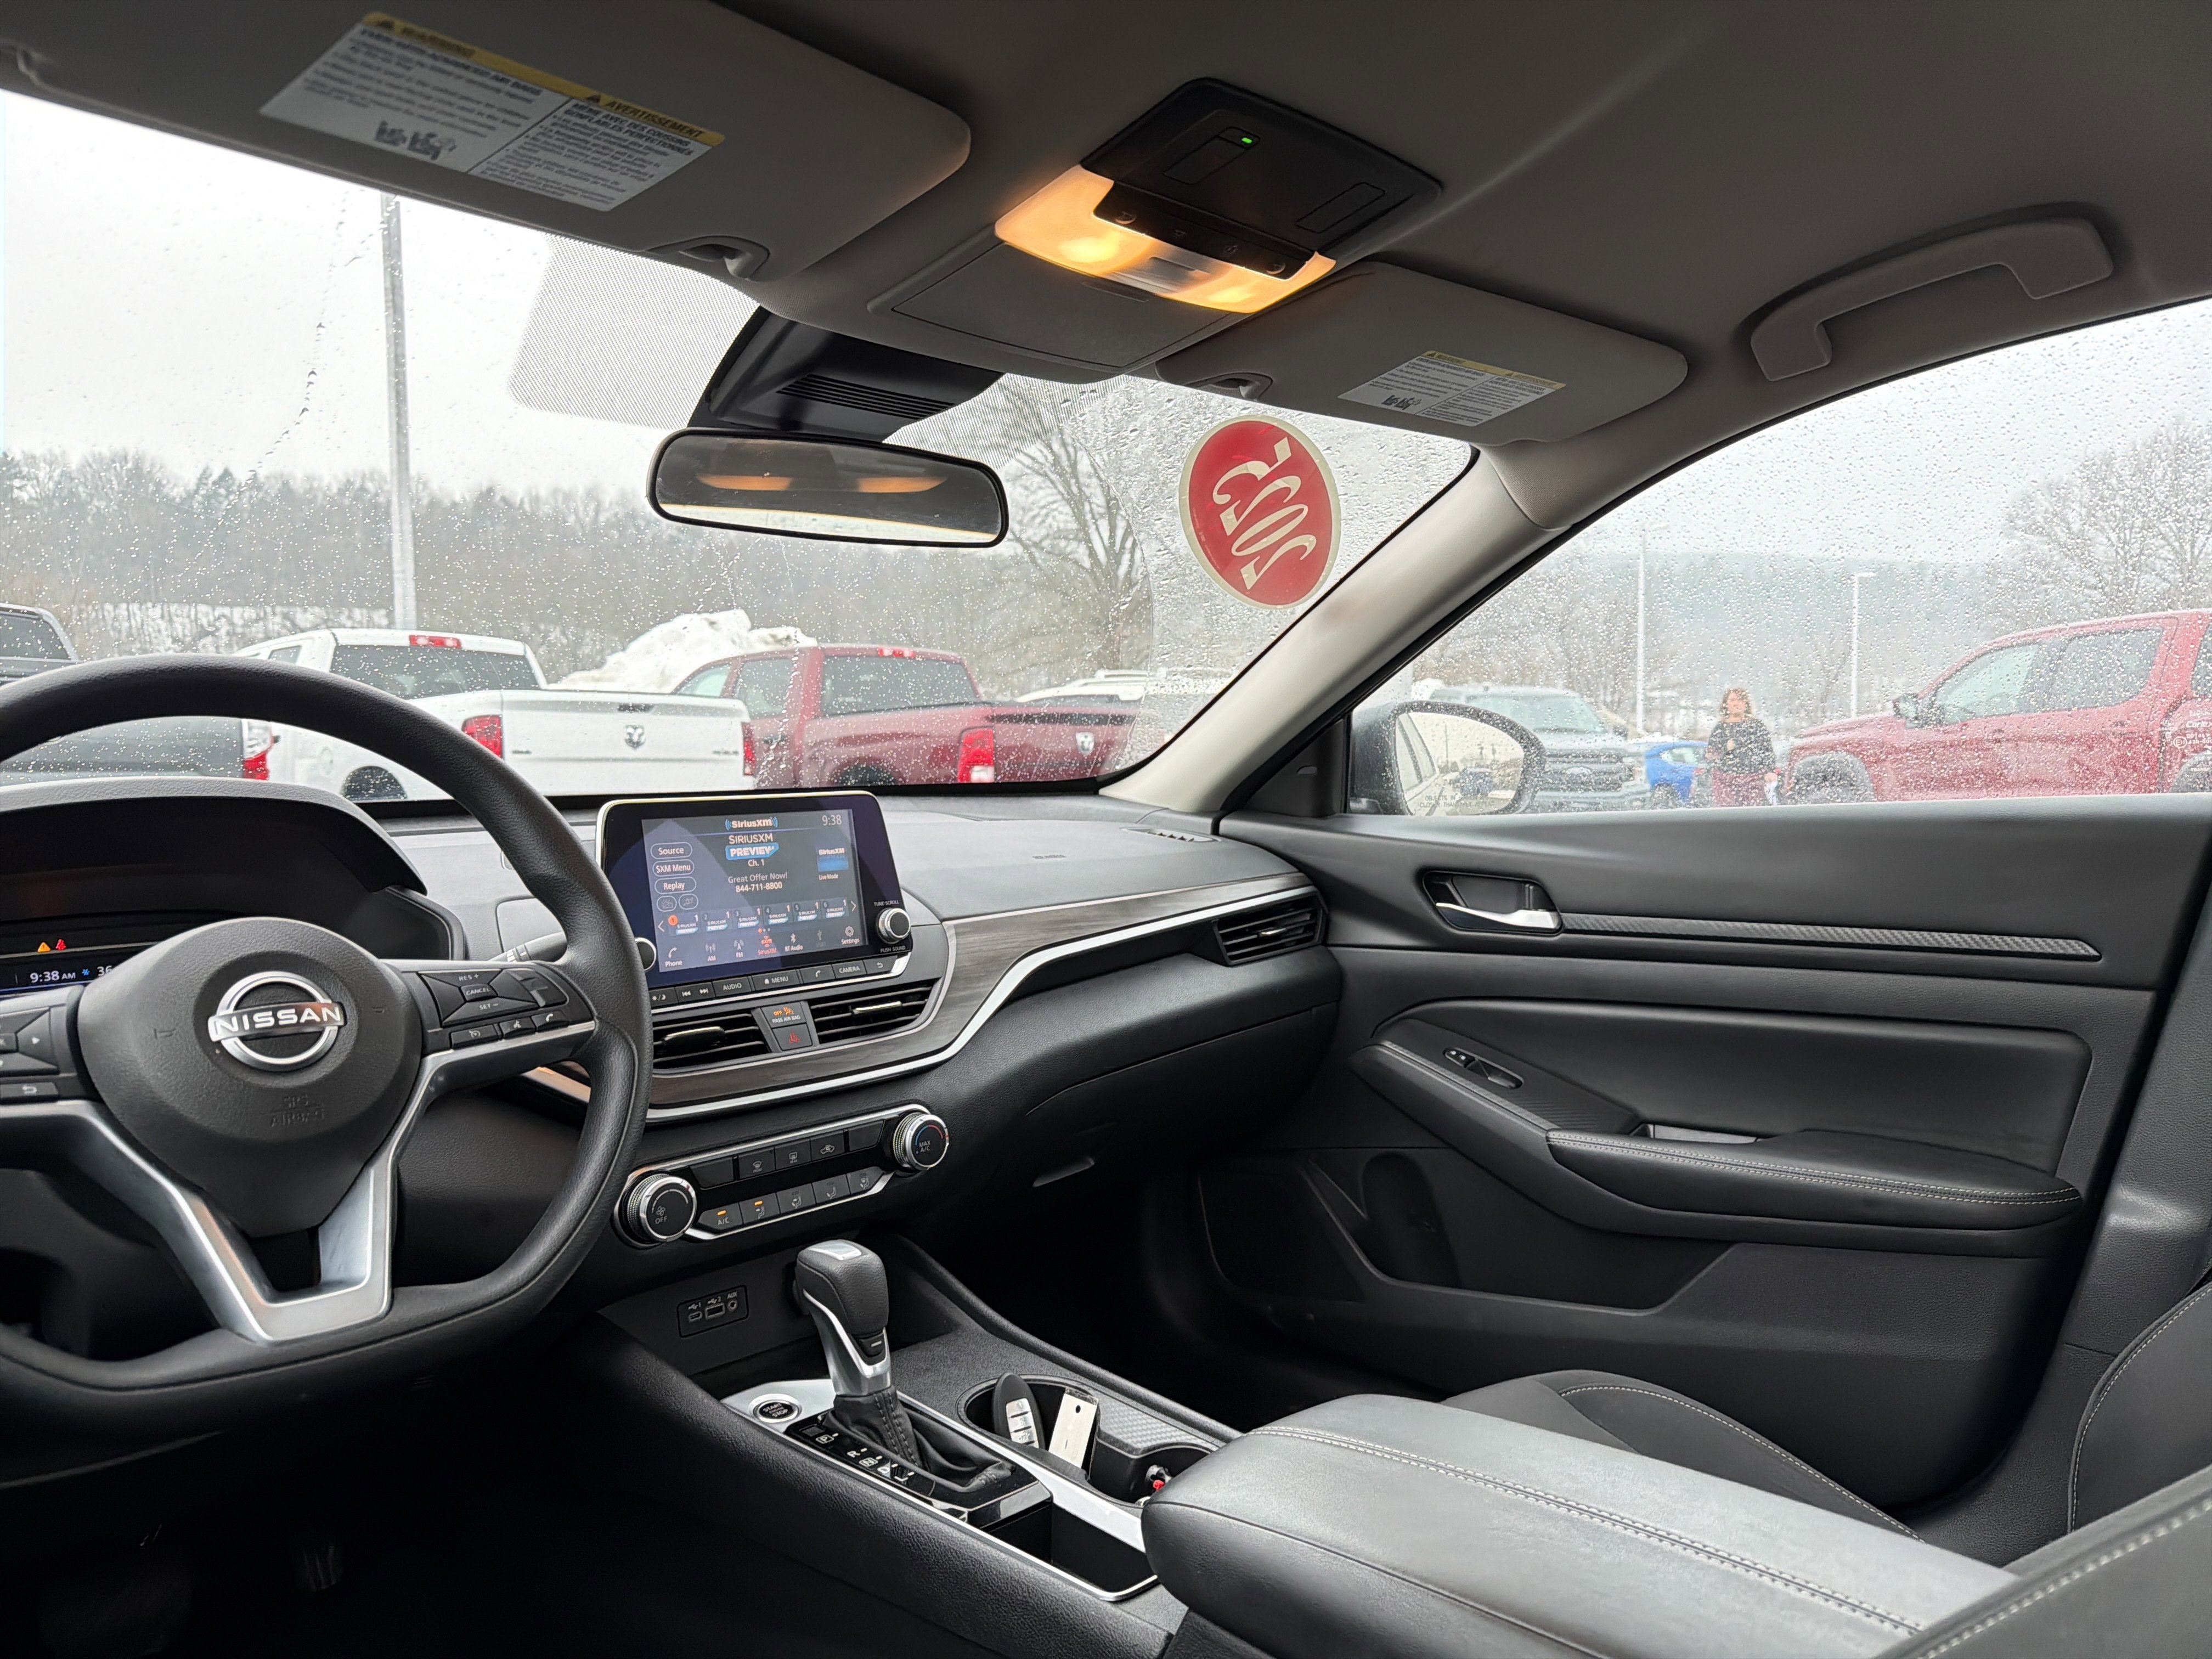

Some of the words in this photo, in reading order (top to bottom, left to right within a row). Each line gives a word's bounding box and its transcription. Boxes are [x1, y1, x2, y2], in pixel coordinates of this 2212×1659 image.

[605, 100, 704, 138] AVERTISSEMENT
[822, 814, 842, 826] 9:38
[729, 833, 774, 845] SIRIUSXM
[658, 847, 685, 855] Source
[730, 845, 775, 857] PREVIEW
[656, 865, 671, 873] SXM
[672, 864, 691, 872] Menu
[728, 874, 748, 883] Great
[749, 873, 768, 882] Offer
[770, 872, 788, 880] Now!
[663, 881, 685, 891] Replay
[736, 882, 782, 893] 844-711-8800
[786, 905, 791, 913] 1
[815, 901, 819, 910] 1
[726, 911, 730, 919] 1
[757, 907, 761, 916] 1
[694, 914, 698, 922] 1
[839, 966, 860, 974] CAMERA
[30, 970, 60, 983] 9:38
[723, 983, 742, 991] AUDIO
[213, 1006, 341, 1036] NISSAN
[655, 1216, 668, 1224] OFF
[718, 1217, 730, 1226] A/C
[763, 1403, 782, 1412] START
[772, 1408, 788, 1417] STOP
